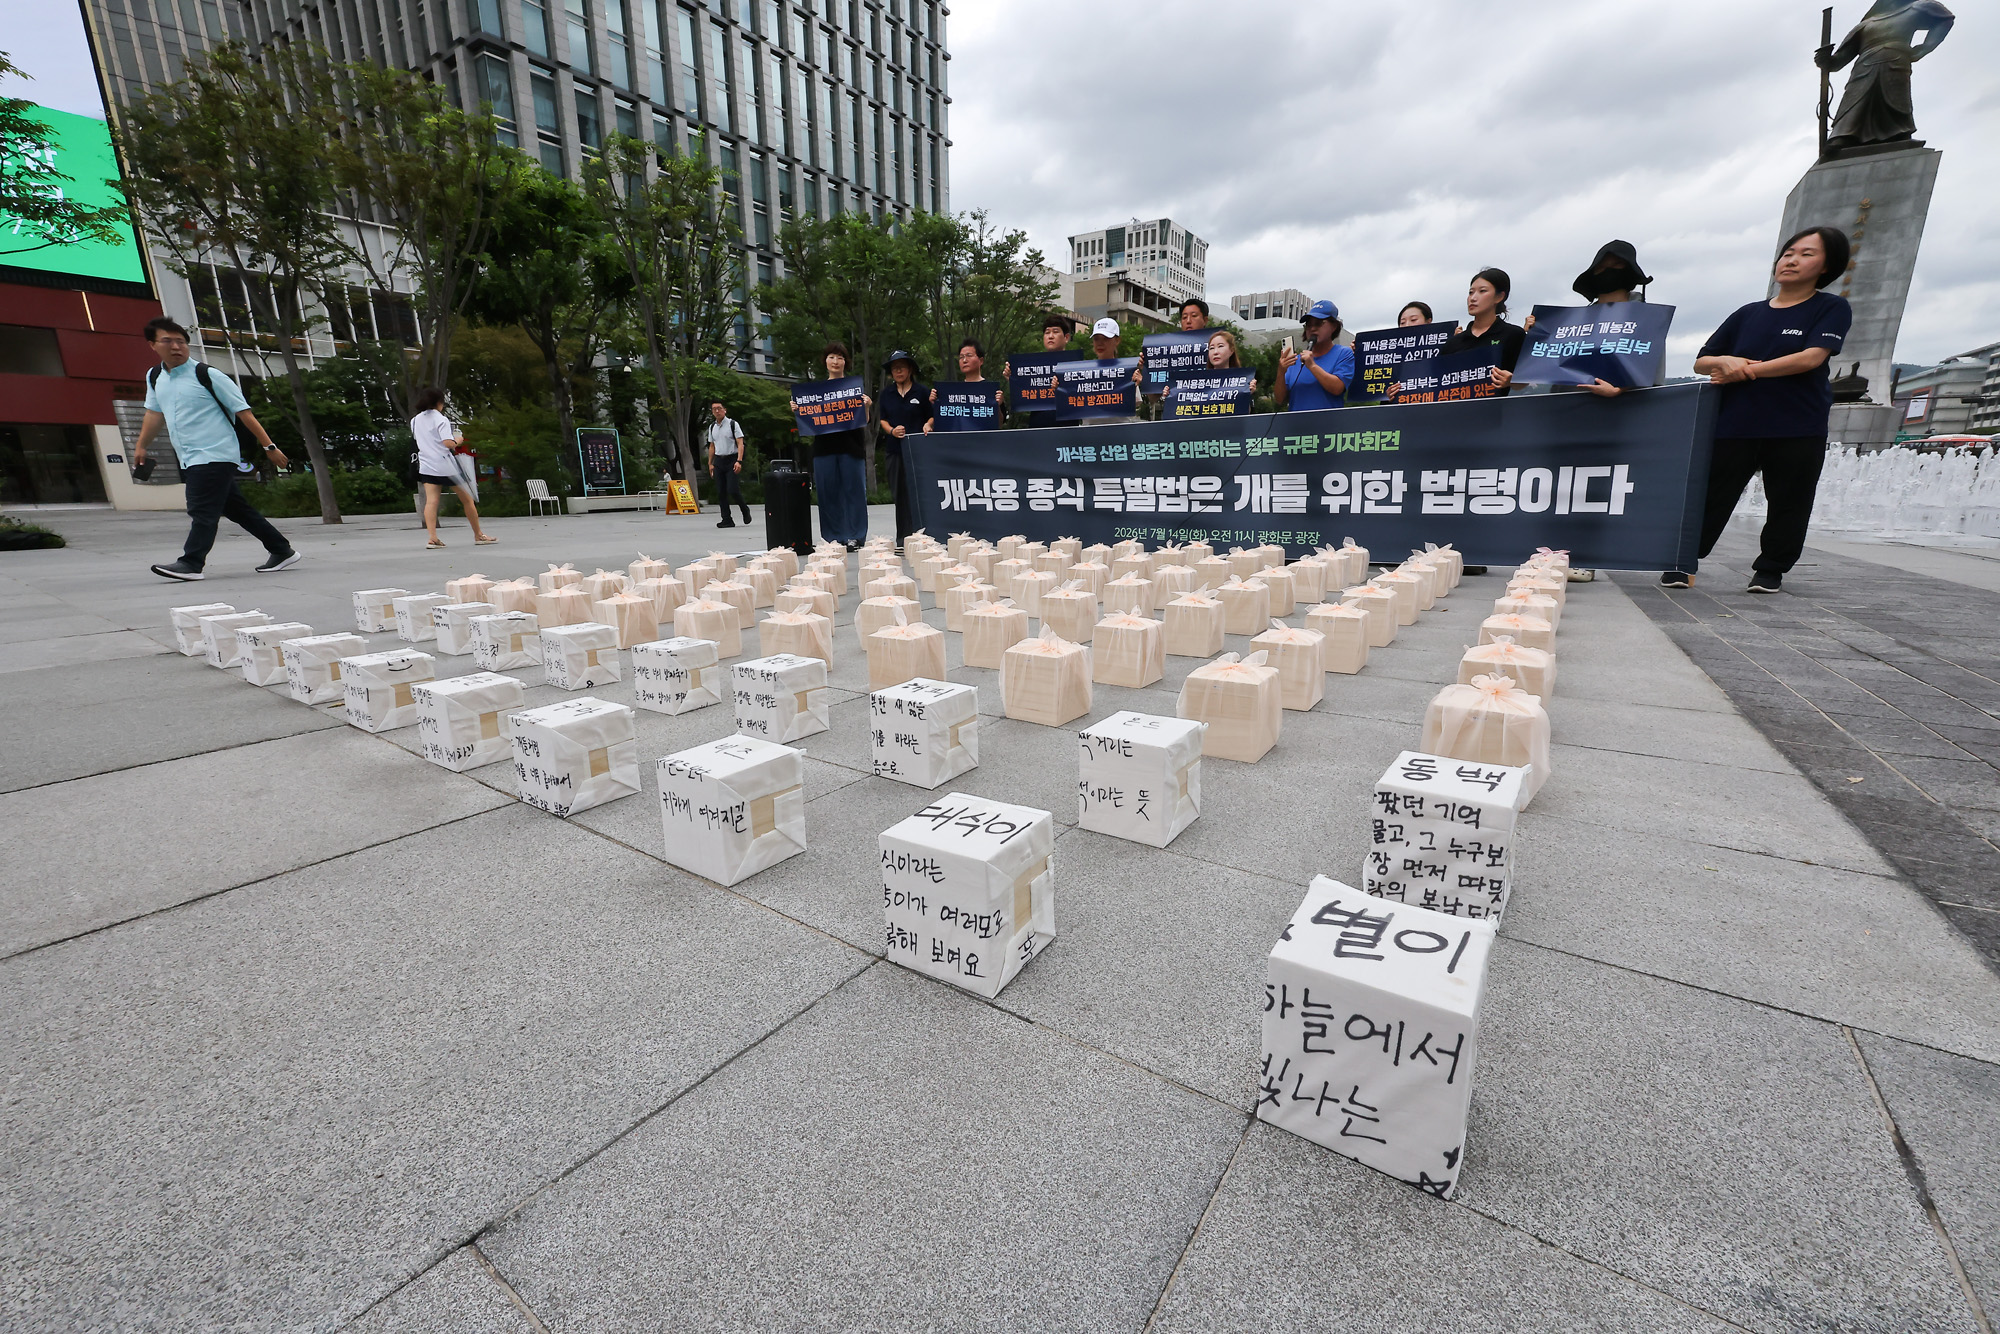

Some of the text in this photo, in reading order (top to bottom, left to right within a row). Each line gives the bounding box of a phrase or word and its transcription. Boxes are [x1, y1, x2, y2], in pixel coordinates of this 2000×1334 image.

[1555, 321, 1638, 339] 방치된 개농장
[1146, 345, 1168, 357] 정부가
[1170, 344, 1192, 355] 세어야
[1193, 343, 1202, 353] 할
[1362, 333, 1448, 352] 개식용종식법 시행은
[1531, 338, 1651, 358] 방관하는 농림부
[1171, 356, 1192, 367] 농장이
[1365, 348, 1440, 366] 대책없는 쇼인가?
[1017, 365, 1051, 376] 생존견에게
[1064, 368, 1125, 381] 생존견에게 복날은
[1149, 371, 1169, 383] 개들!
[1363, 367, 1392, 381] 생존견
[1077, 381, 1114, 393] 사형선고다
[1176, 377, 1247, 390] 개식용종식법 시행은
[1366, 382, 1386, 395] 즉각
[1397, 376, 1438, 392] 농림부는
[795, 394, 823, 405] 농림부는
[948, 394, 986, 404] 방치된 개농장
[1021, 387, 1056, 400] 학살 방조
[1068, 393, 1123, 407] 학살 방조마라!
[1177, 390, 1239, 402] 대책없는 쇼인가?
[1438, 387, 1471, 402] 생존해
[799, 398, 863, 416] 현장에 생존해 있는
[940, 405, 994, 417] 방관하는 농림부
[1175, 403, 1235, 416] 생존견 보호계획
[812, 411, 855, 426] 개들을 보라!
[1056, 430, 1401, 463] 개식용 산업 생존견 외면하는 정부 규탄 기자회견
[937, 464, 1635, 515] 개식용 종식 특별법은 개를 위한 법령이다
[1114, 527, 1148, 539] 2026년
[1150, 528, 1166, 541] 7월
[1209, 529, 1231, 543] 오전
[1234, 530, 1254, 543] 11시
[1257, 531, 1293, 545] 광화문
[1295, 531, 1321, 545] 광장
[895, 698, 904, 714] 새
[895, 733, 922, 755] 바라는
[663, 791, 747, 834] 귀하게 여겨지길
[1136, 789, 1150, 821] 뜻
[1374, 791, 1482, 830] 팠던 기억
[914, 806, 1033, 845] 대식이
[1373, 819, 1504, 867] 물고, 그 누구보
[881, 849, 946, 884] 식이라는
[1369, 852, 1391, 876] 장
[1403, 858, 1448, 882] 먼저
[1310, 900, 1471, 973] 별이
[932, 938, 987, 978] 보여요
[1265, 985, 1465, 1085] 하늘에서
